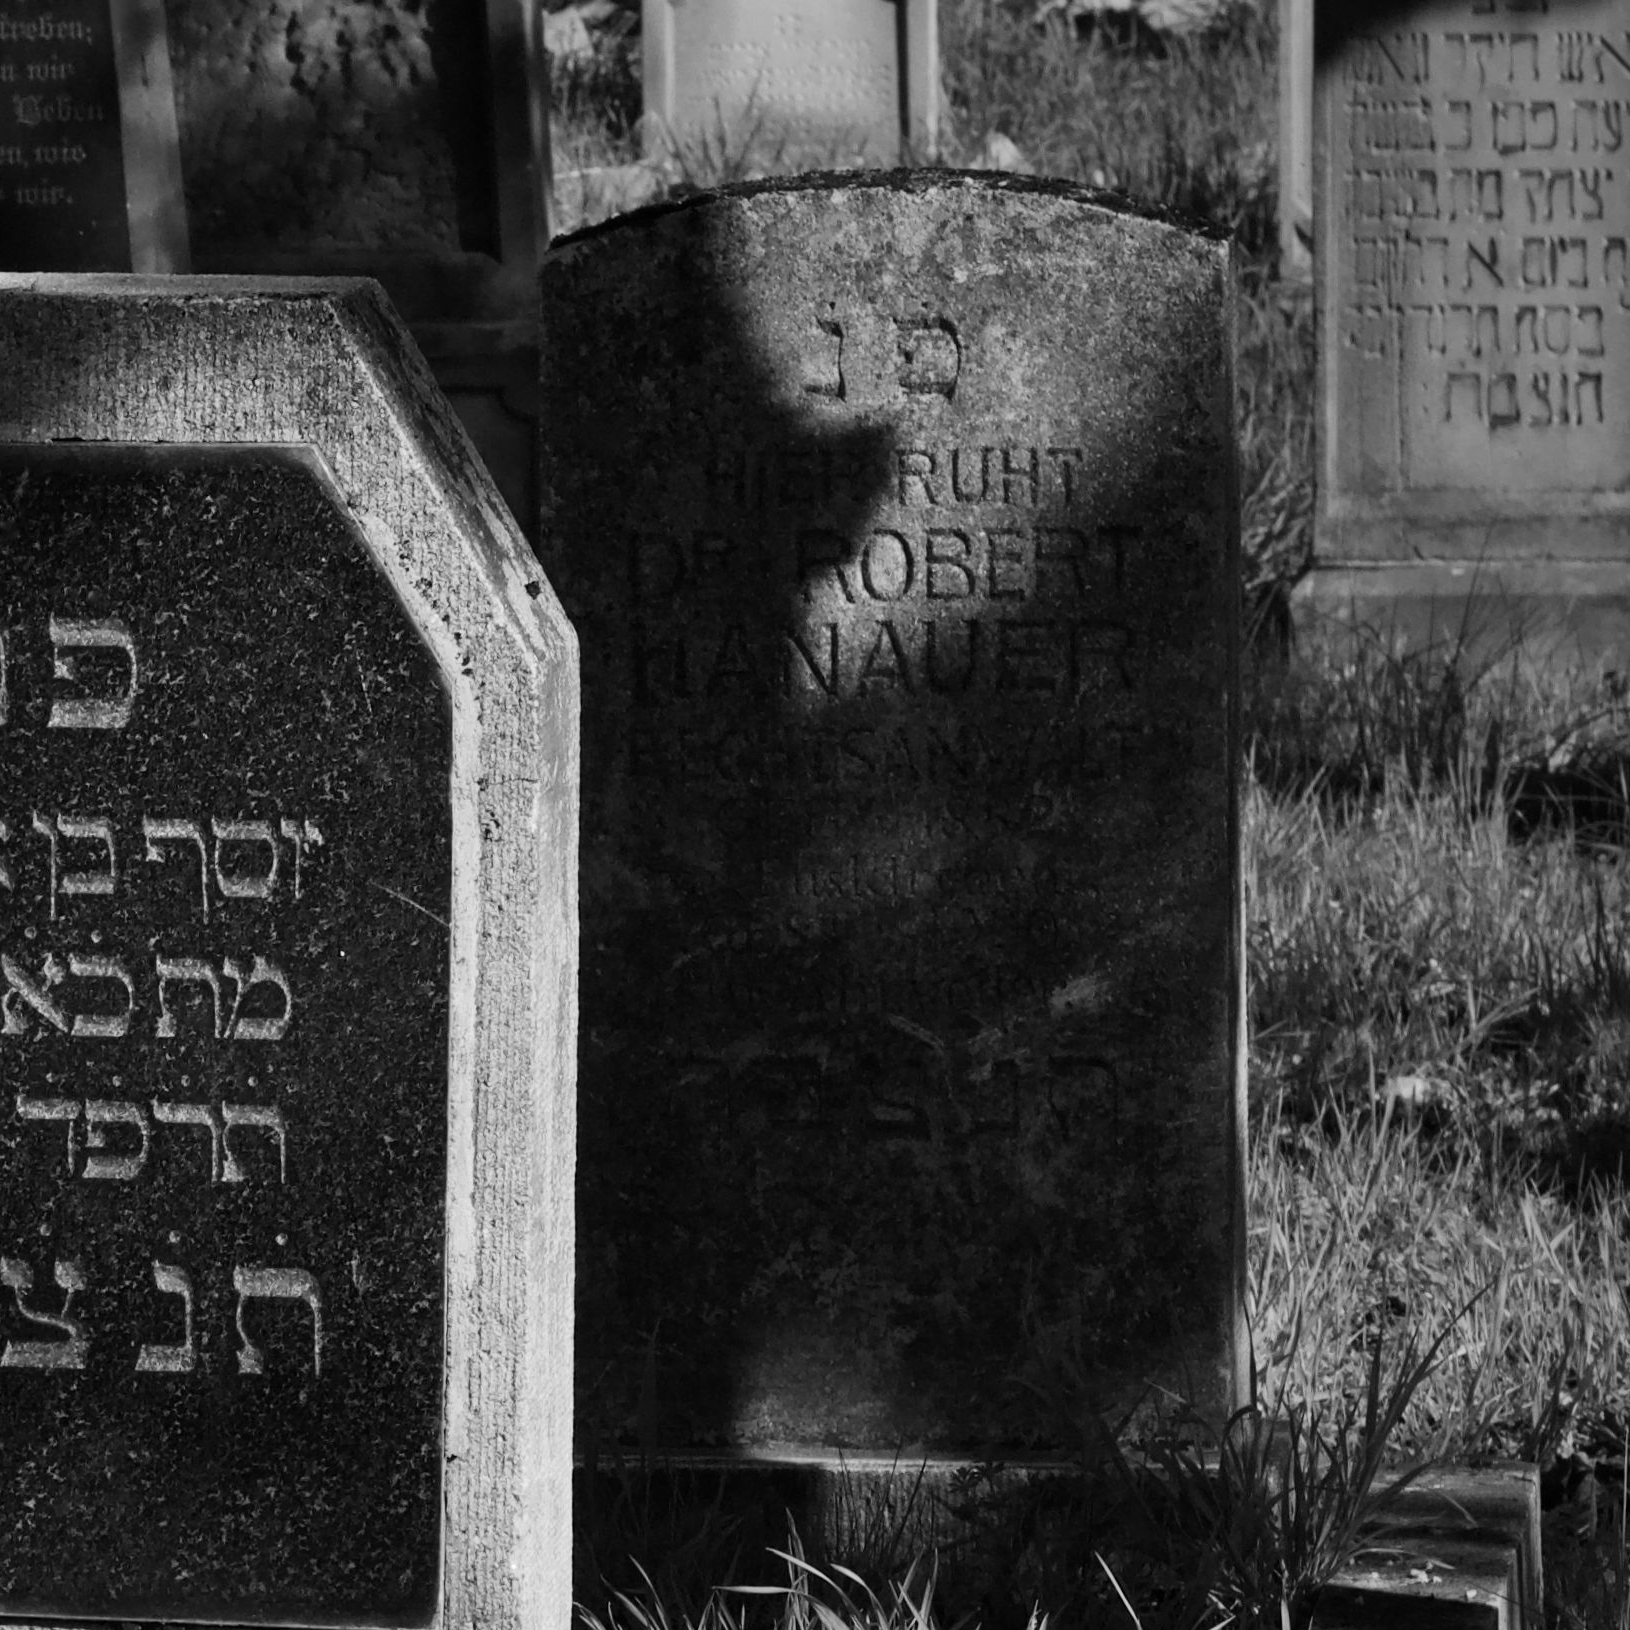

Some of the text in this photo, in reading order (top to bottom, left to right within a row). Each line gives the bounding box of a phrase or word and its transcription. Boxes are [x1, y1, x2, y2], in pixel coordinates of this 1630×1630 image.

[897, 446, 1084, 507] RUHT
[795, 524, 1144, 604] ROBERT
[635, 618, 1140, 701] HANAUER
[31, 808, 116, 921] בן
[141, 813, 325, 924] יוסף
